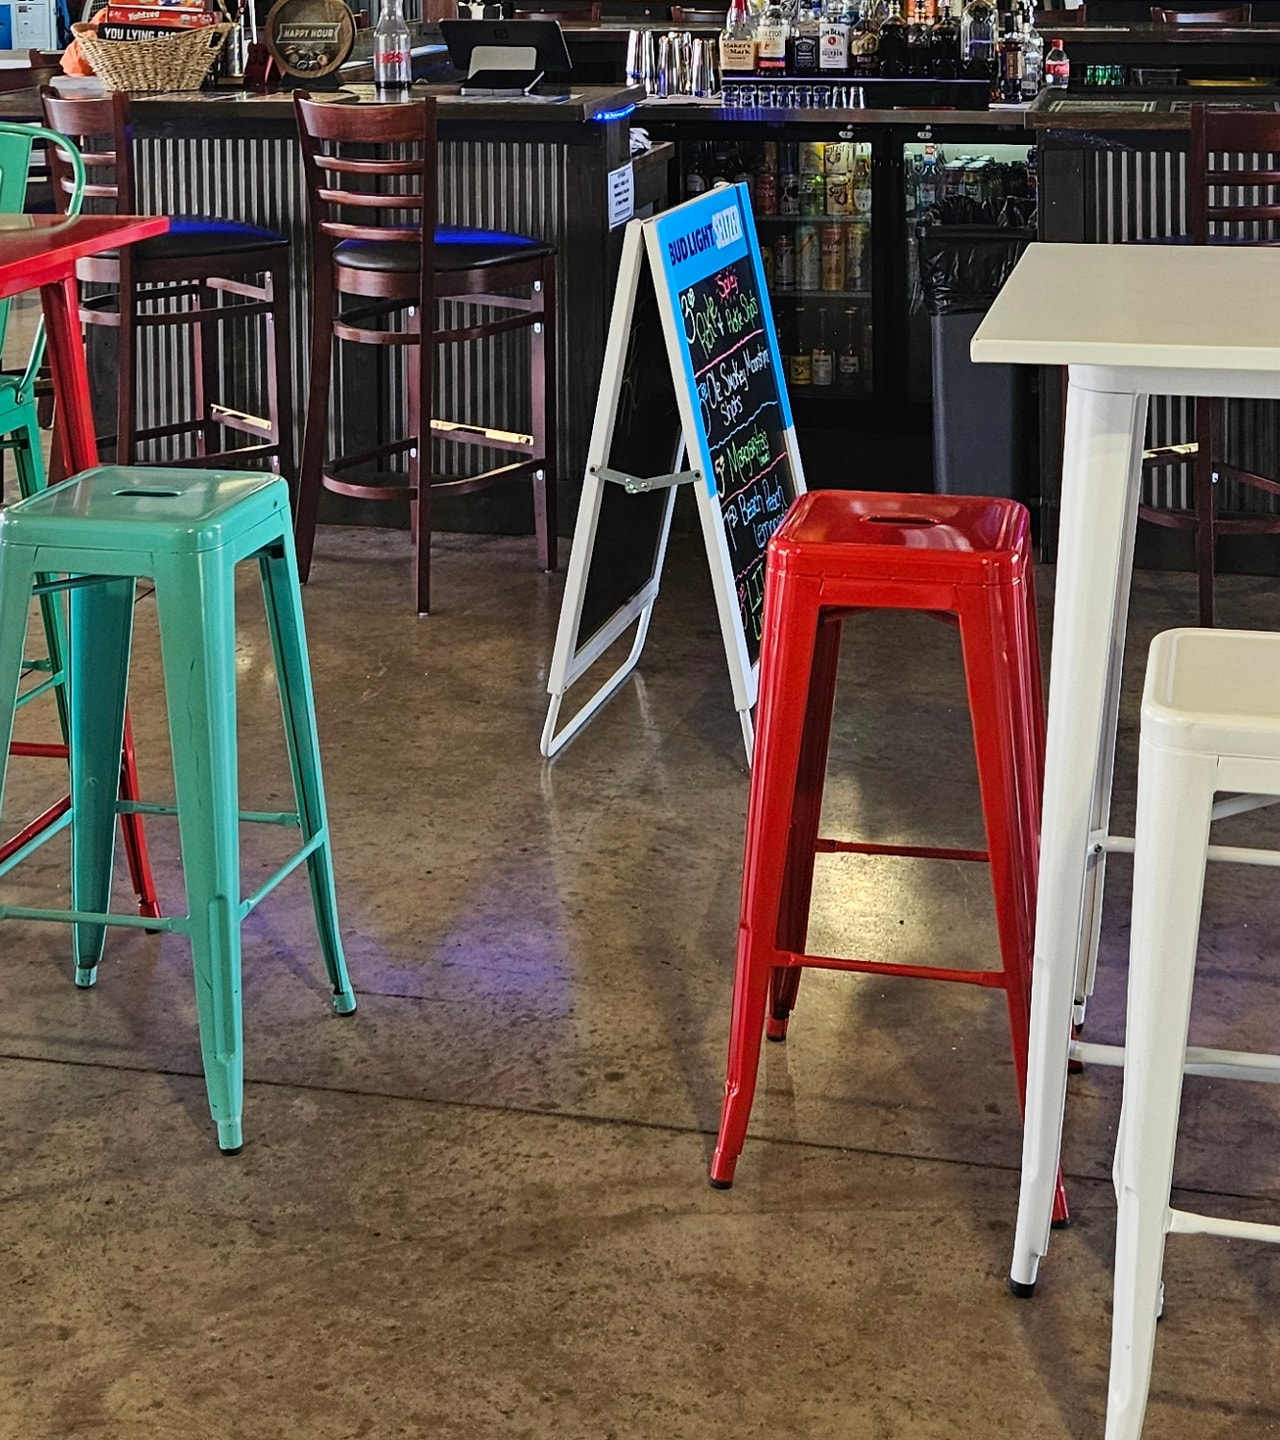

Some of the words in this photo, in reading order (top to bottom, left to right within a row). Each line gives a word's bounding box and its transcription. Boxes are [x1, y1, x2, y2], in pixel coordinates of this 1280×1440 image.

[128, 10, 161, 22] Yahtzee
[104, 27, 125, 40] YOU
[126, 28, 156, 41] LYING
[283, 29, 309, 38] HAPPY
[310, 28, 334, 37] HOUR
[729, 48, 751, 56] Mark
[668, 240, 688, 266] BUD
[686, 224, 716, 258] LIGHT
[737, 483, 764, 527] Beach
